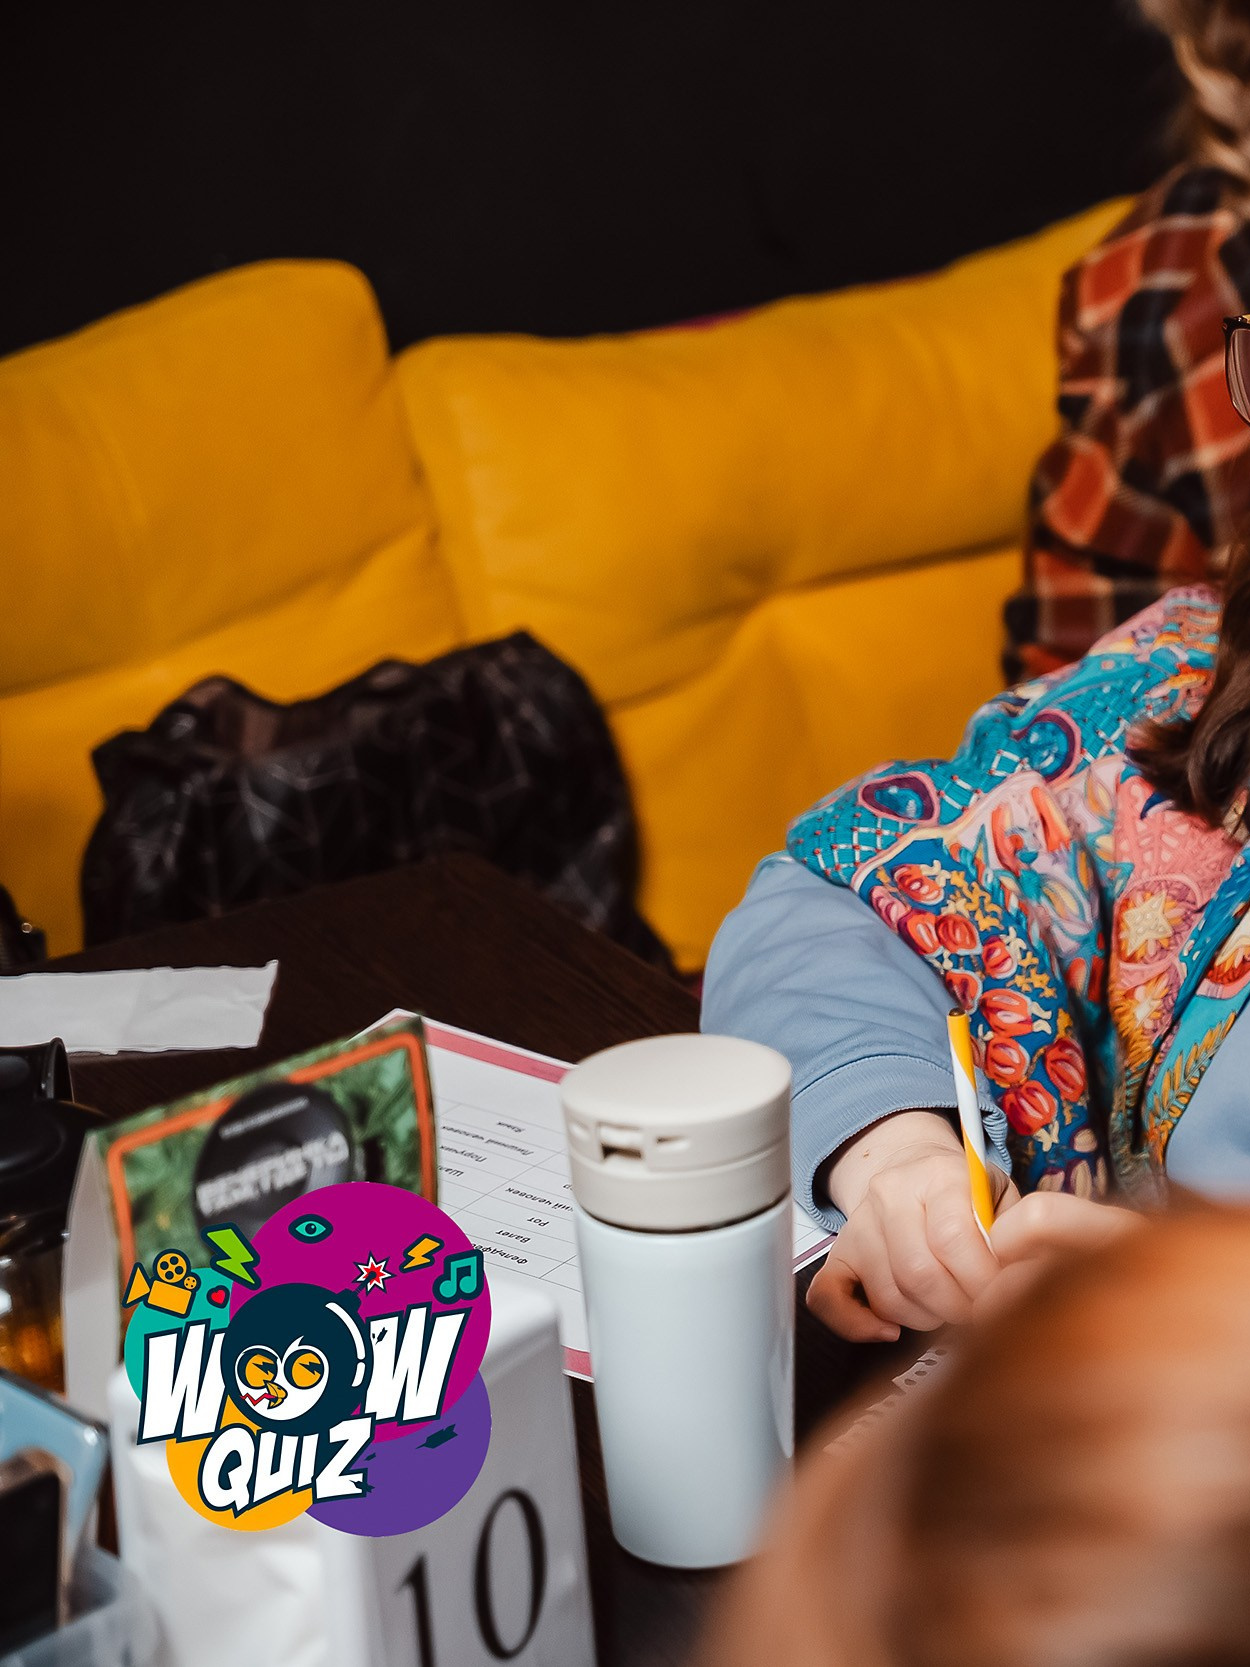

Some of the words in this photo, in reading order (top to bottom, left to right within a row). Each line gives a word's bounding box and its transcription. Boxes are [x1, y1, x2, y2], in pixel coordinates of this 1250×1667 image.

[441, 1125, 485, 1141] человек
[439, 1144, 487, 1163] Поручик
[485, 1137, 534, 1156] Лишний
[436, 1165, 464, 1178] Шал
[505, 1187, 552, 1206] человек
[527, 1216, 550, 1227] Рот
[495, 1229, 531, 1244] Валет
[400, 1487, 548, 1667] 10
